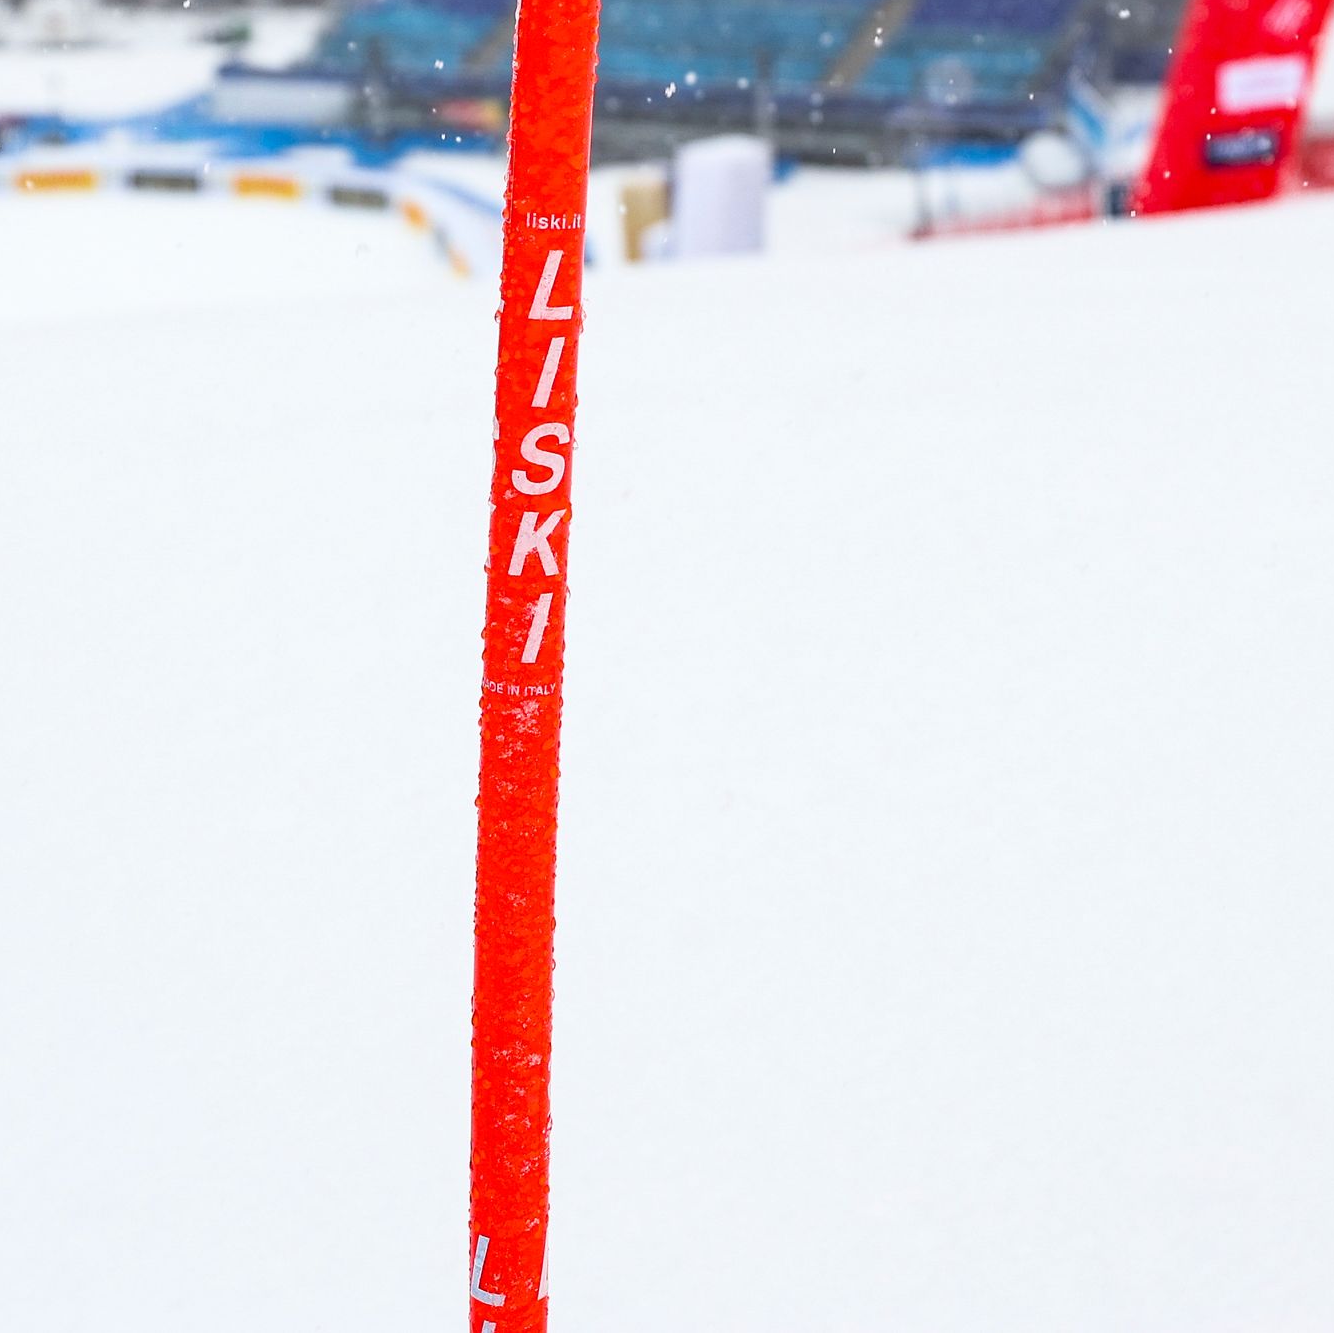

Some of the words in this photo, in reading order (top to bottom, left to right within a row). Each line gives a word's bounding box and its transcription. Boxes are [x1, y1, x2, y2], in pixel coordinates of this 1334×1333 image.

[526, 212, 581, 230] liski.it
[508, 249, 573, 664] LISKI
[524, 683, 556, 696] ITALY
